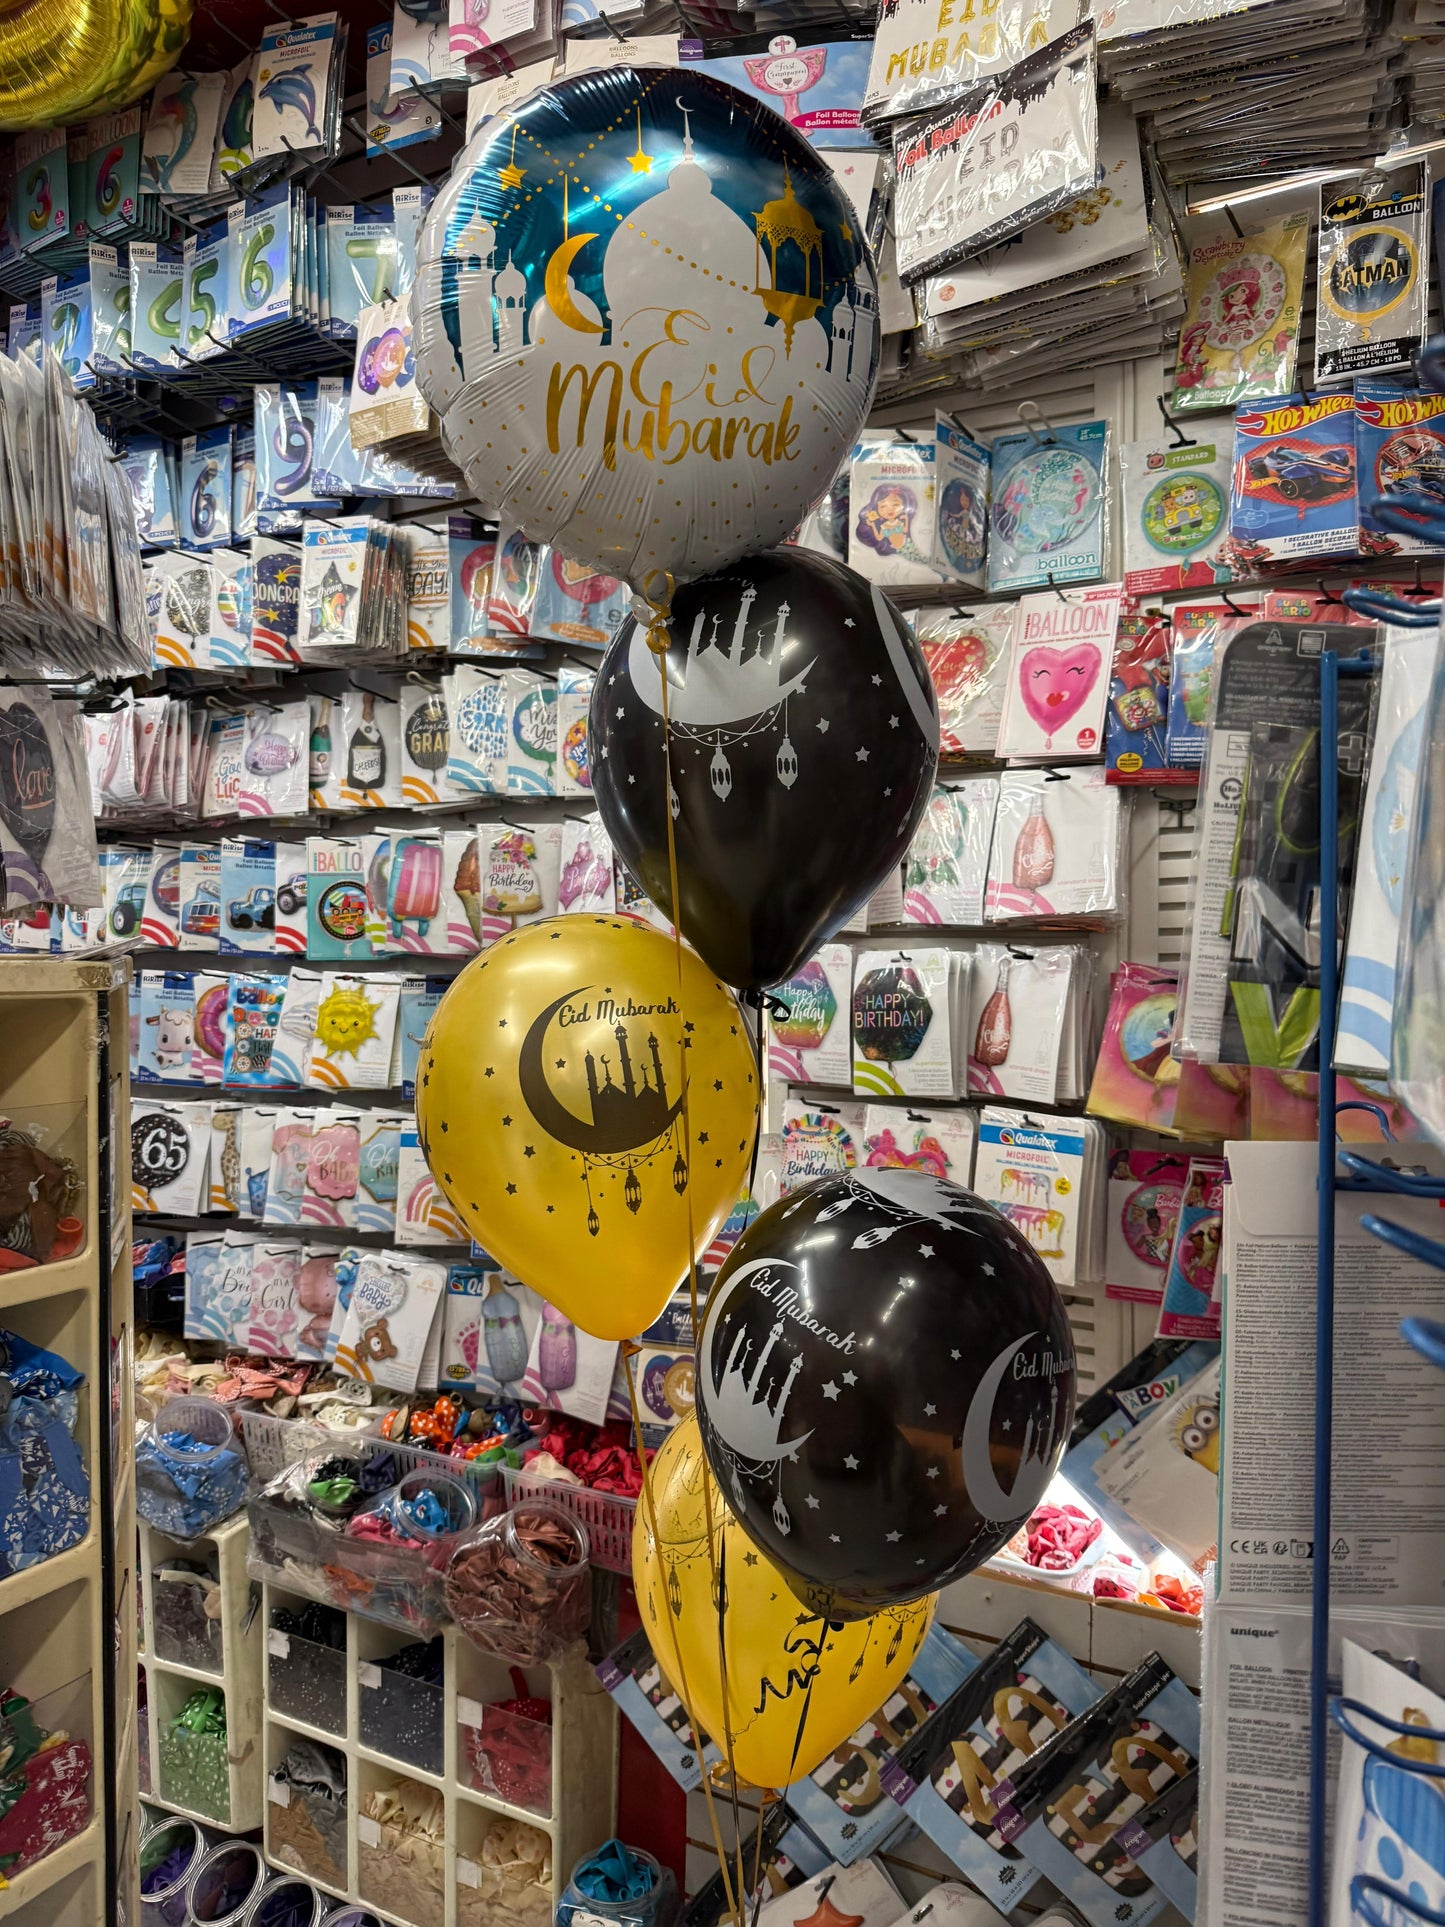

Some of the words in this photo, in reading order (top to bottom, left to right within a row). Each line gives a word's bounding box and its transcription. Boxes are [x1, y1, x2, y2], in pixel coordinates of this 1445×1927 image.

[1372, 201, 1421, 219] BALLOON
[620, 307, 777, 408] Eid
[1369, 341, 1396, 352] BALLOON
[546, 360, 802, 472] Mubarak
[1037, 552, 1096, 572] balloon
[1031, 604, 1111, 639] BALLOON
[13, 738, 56, 801] love
[492, 864, 516, 874] HAPPY
[488, 872, 534, 893] Birthday
[784, 981, 813, 1004] Happy
[866, 993, 911, 1010] HAPPY
[558, 1003, 590, 1028] Eid
[596, 996, 681, 1025] Mubarak
[855, 1009, 924, 1028] BIRTHDAY!
[141, 1127, 188, 1170] 65
[1015, 1131, 1059, 1150] Qualatex
[796, 1150, 829, 1162] HAPPY
[1006, 1150, 1050, 1164] MICROFOIL
[261, 1285, 295, 1310] Girl
[750, 1267, 781, 1297] Eid
[771, 1286, 857, 1355] Mubarak
[1013, 1352, 1039, 1381] Eid
[1138, 1379, 1176, 1406] BOY
